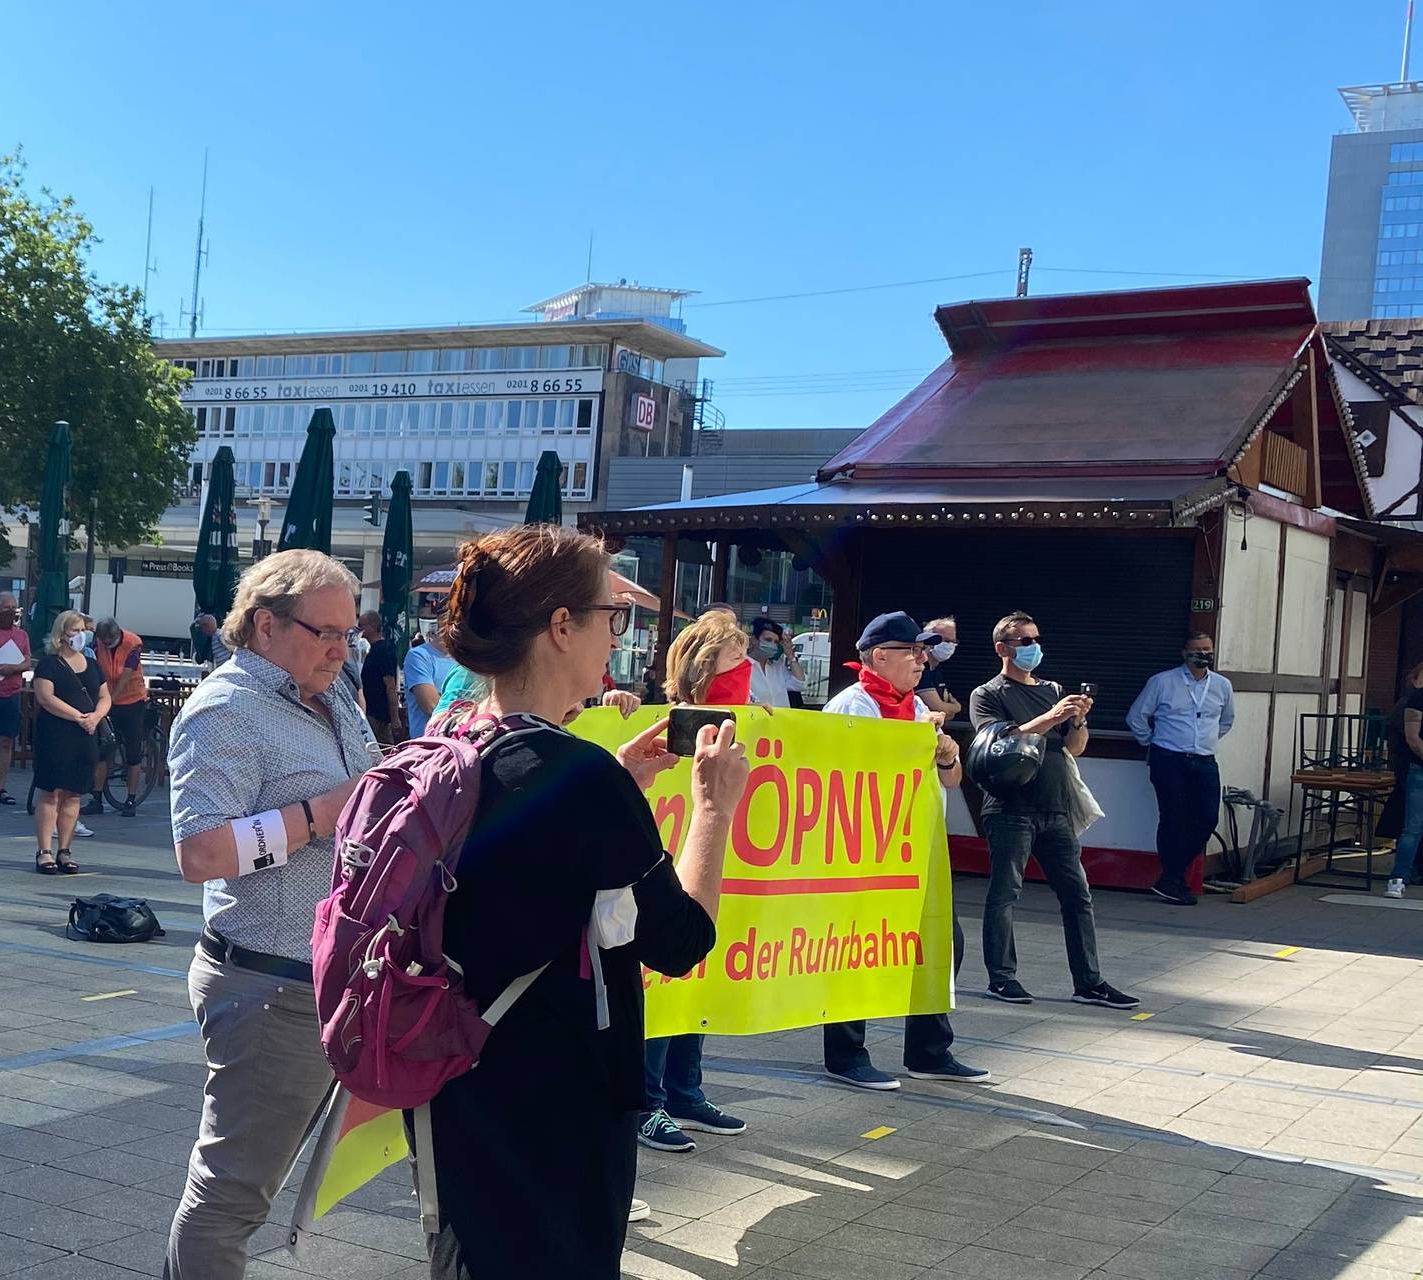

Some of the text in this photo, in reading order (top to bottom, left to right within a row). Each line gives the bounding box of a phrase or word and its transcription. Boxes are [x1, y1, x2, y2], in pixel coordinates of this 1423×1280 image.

[205, 387, 223, 396] 0201
[224, 387, 232, 399] 8
[234, 387, 249, 399] 66
[253, 386, 267, 398] 55
[349, 383, 368, 393] 0201
[372, 383, 388, 396] 19
[391, 382, 416, 396] 410
[506, 379, 527, 389] 0201
[530, 379, 539, 392] 8
[543, 379, 560, 392] 66
[565, 378, 582, 391] 55
[638, 400, 653, 425] DB
[149, 561, 166, 571] Press
[173, 563, 194, 572] Books
[1193, 600, 1211, 610] 219
[731, 737, 923, 867] ÖPNV!
[724, 926, 784, 982] der
[788, 917, 924, 977] Ruhrbahn
